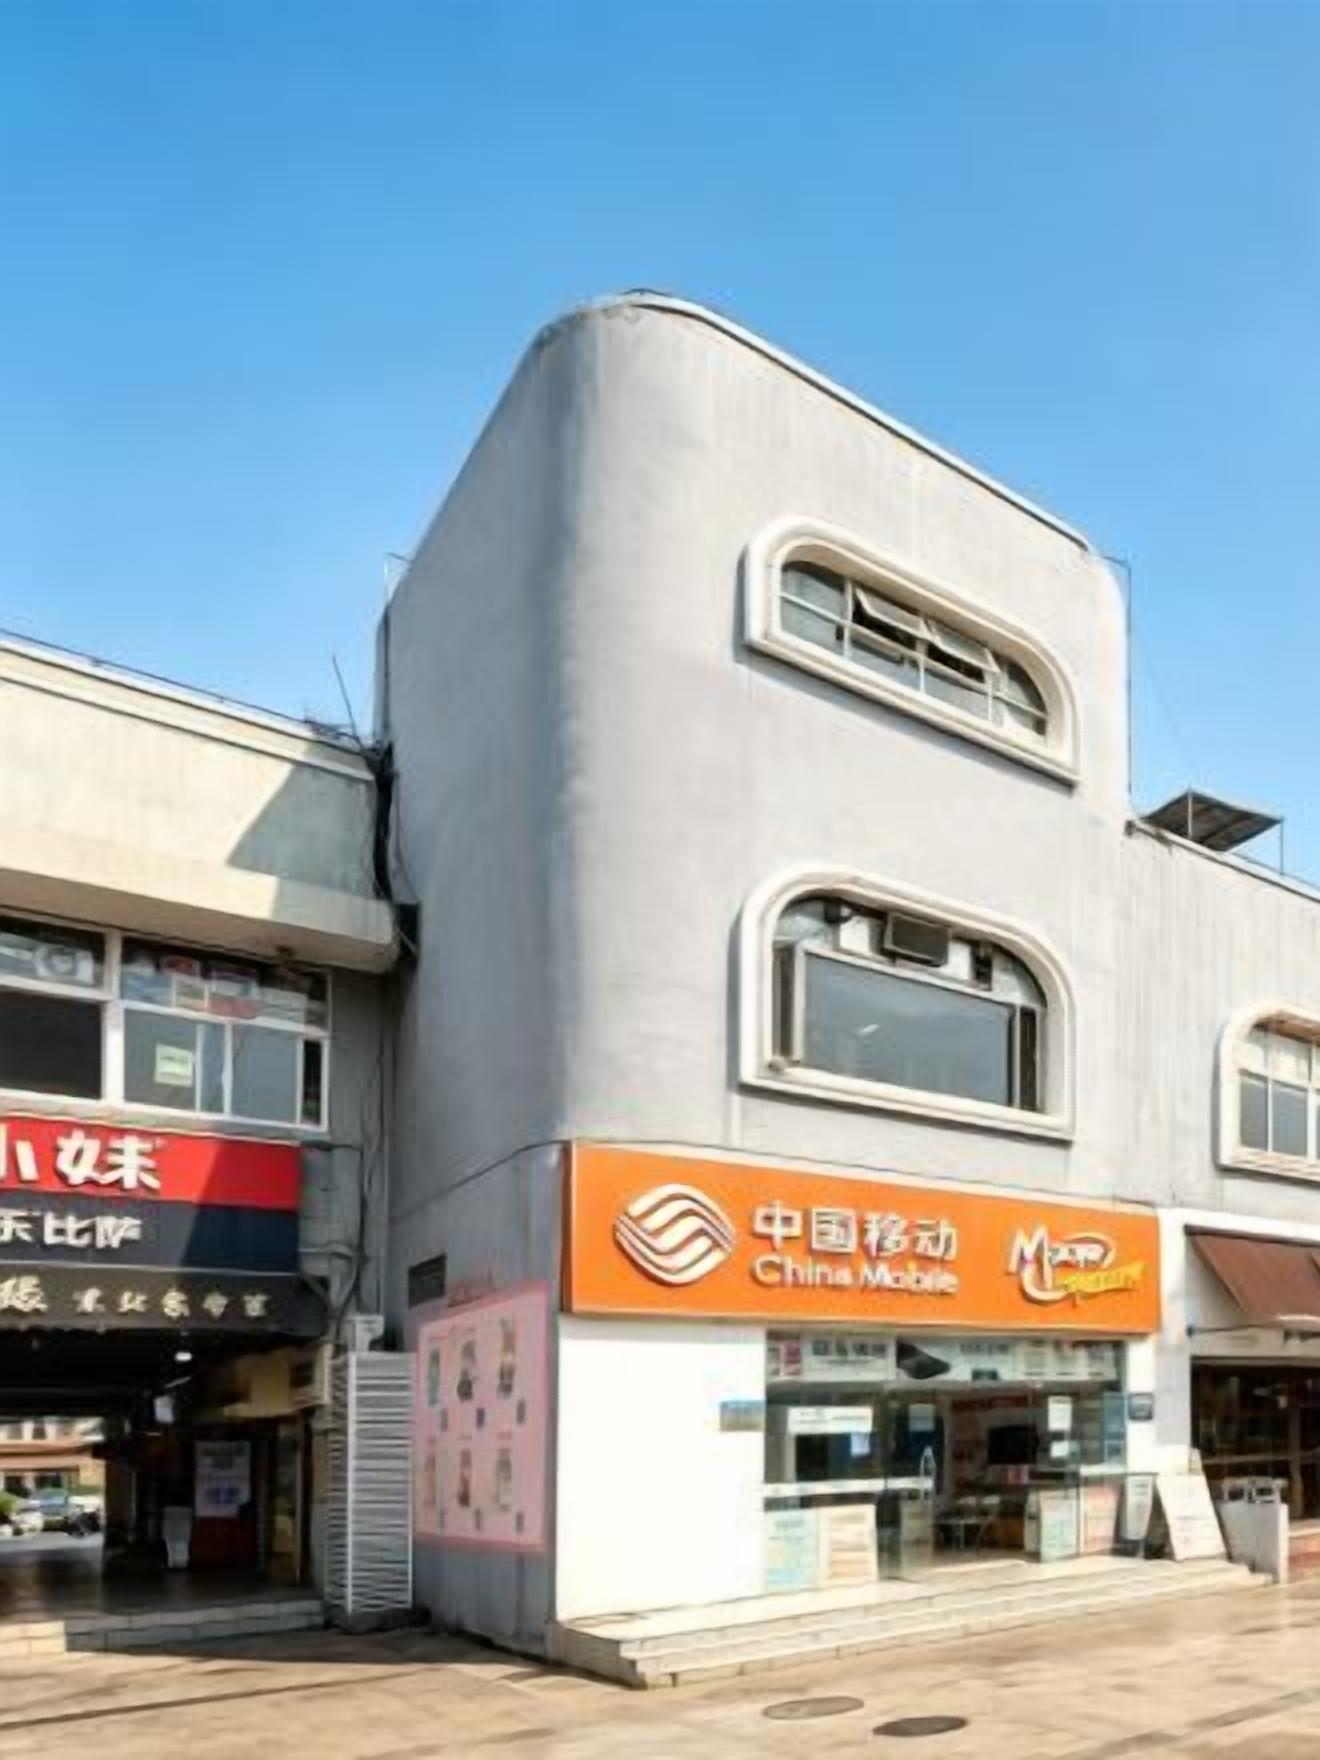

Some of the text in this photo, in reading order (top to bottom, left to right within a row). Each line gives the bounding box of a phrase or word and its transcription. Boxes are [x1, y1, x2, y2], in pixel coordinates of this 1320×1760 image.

[753, 1199, 958, 1260] 中国移动
[754, 1252, 959, 1294] China Mobile
